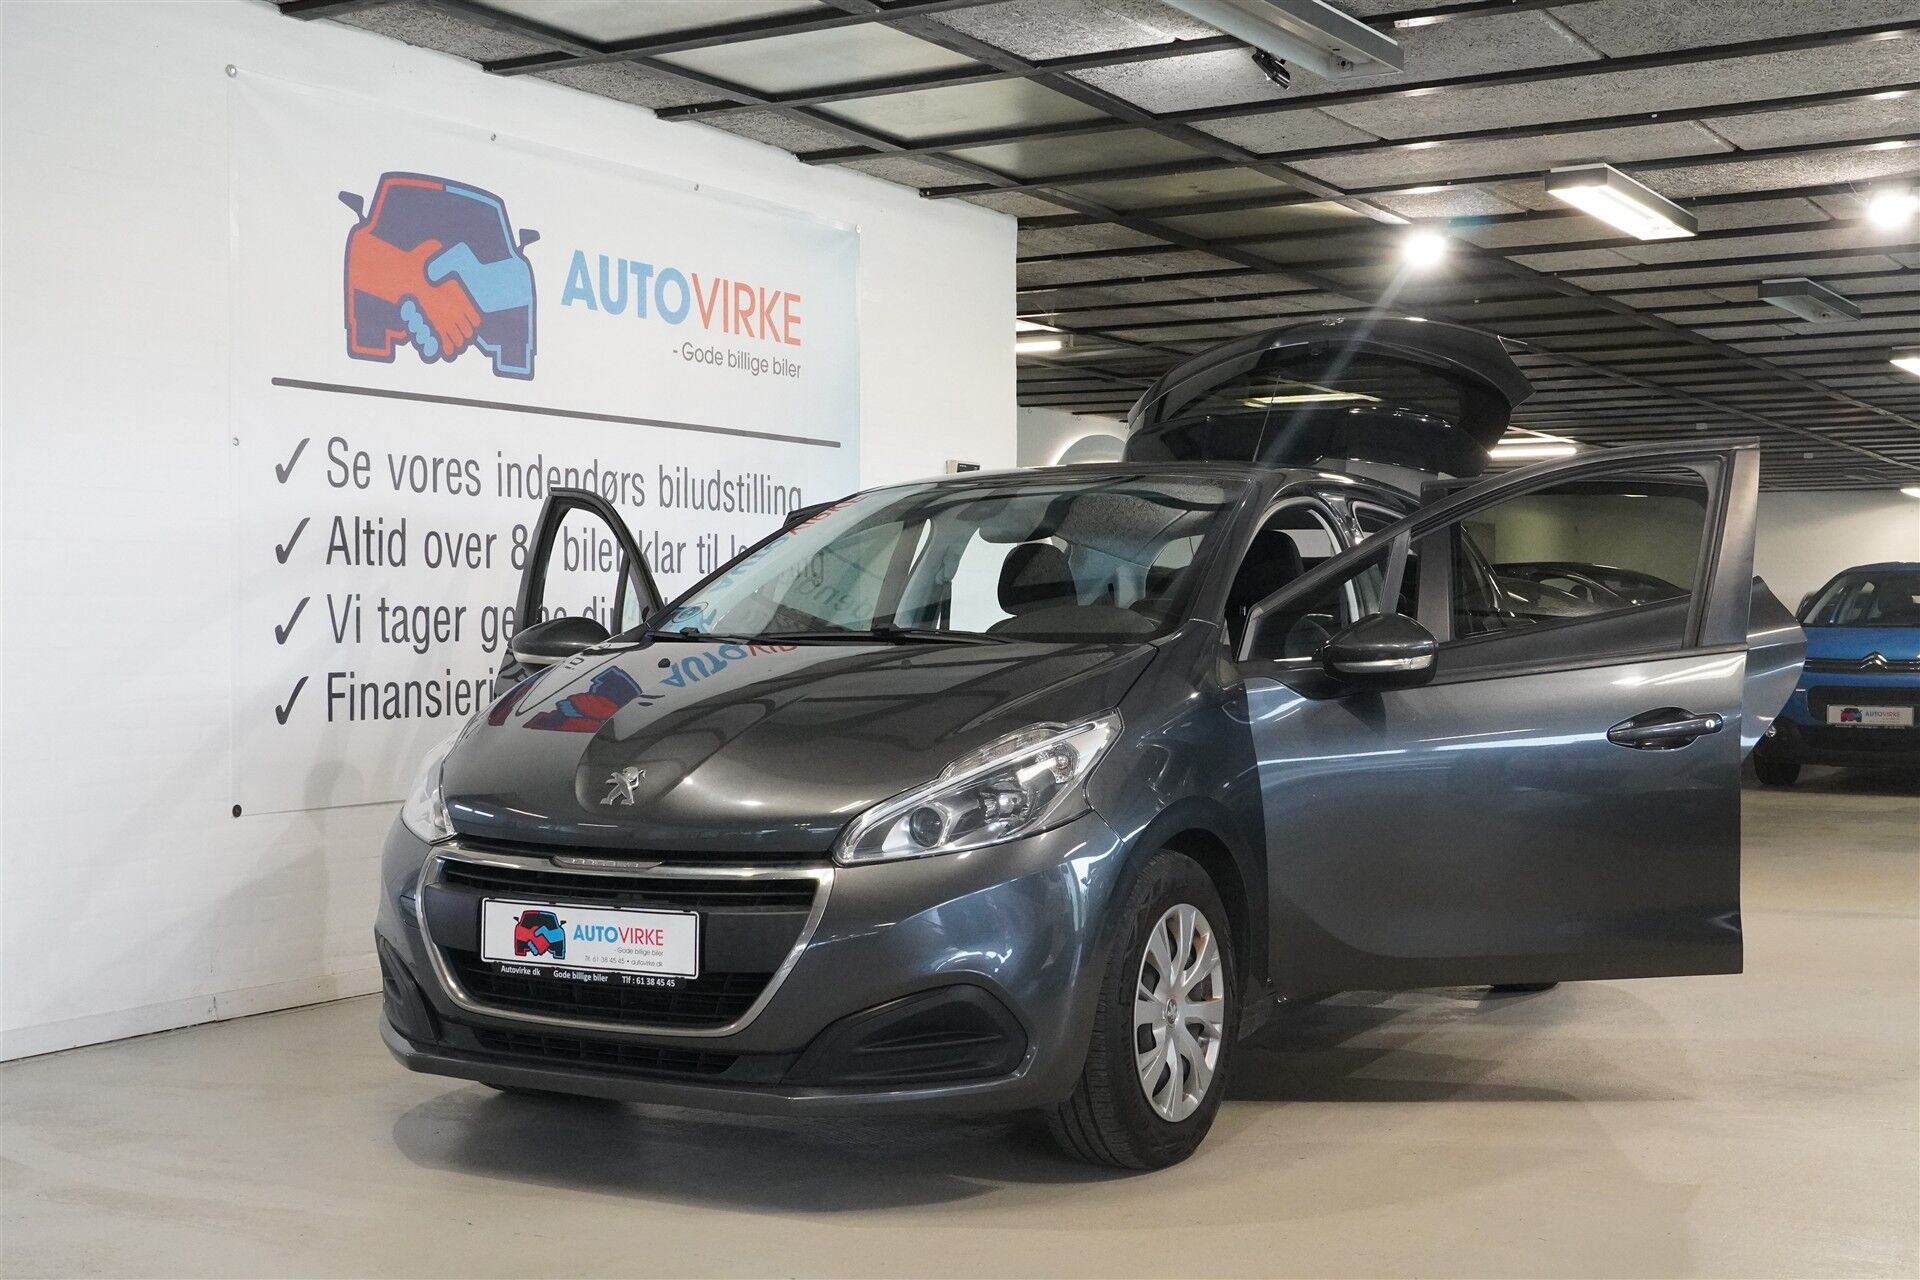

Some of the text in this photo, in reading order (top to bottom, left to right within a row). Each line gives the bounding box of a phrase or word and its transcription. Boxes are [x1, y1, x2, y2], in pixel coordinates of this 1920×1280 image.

[561, 249, 801, 346] AUTOVIRKE
[682, 341, 723, 366] Gode
[727, 349, 769, 377] billige
[772, 356, 801, 378] biler
[327, 436, 801, 515] Se vores indendørs biludstilling
[326, 515, 406, 568] Altid
[424, 530, 497, 569] over
[511, 523, 530, 571] 8
[639, 529, 687, 574] klar
[696, 532, 718, 575] til
[326, 593, 361, 644] Vi
[377, 597, 467, 655] tager
[327, 667, 495, 722] Finansieri
[573, 924, 664, 946] AUTOVIRKE
[617, 947, 633, 955] Gode
[501, 965, 531, 976] Autovirke
[553, 970, 571, 980] Gode
[572, 971, 592, 982] billige
[593, 973, 608, 983] biler
[636, 976, 645, 985] 61
[646, 977, 655, 986] 38
[656, 978, 665, 987] 45
[666, 979, 675, 987] 45
